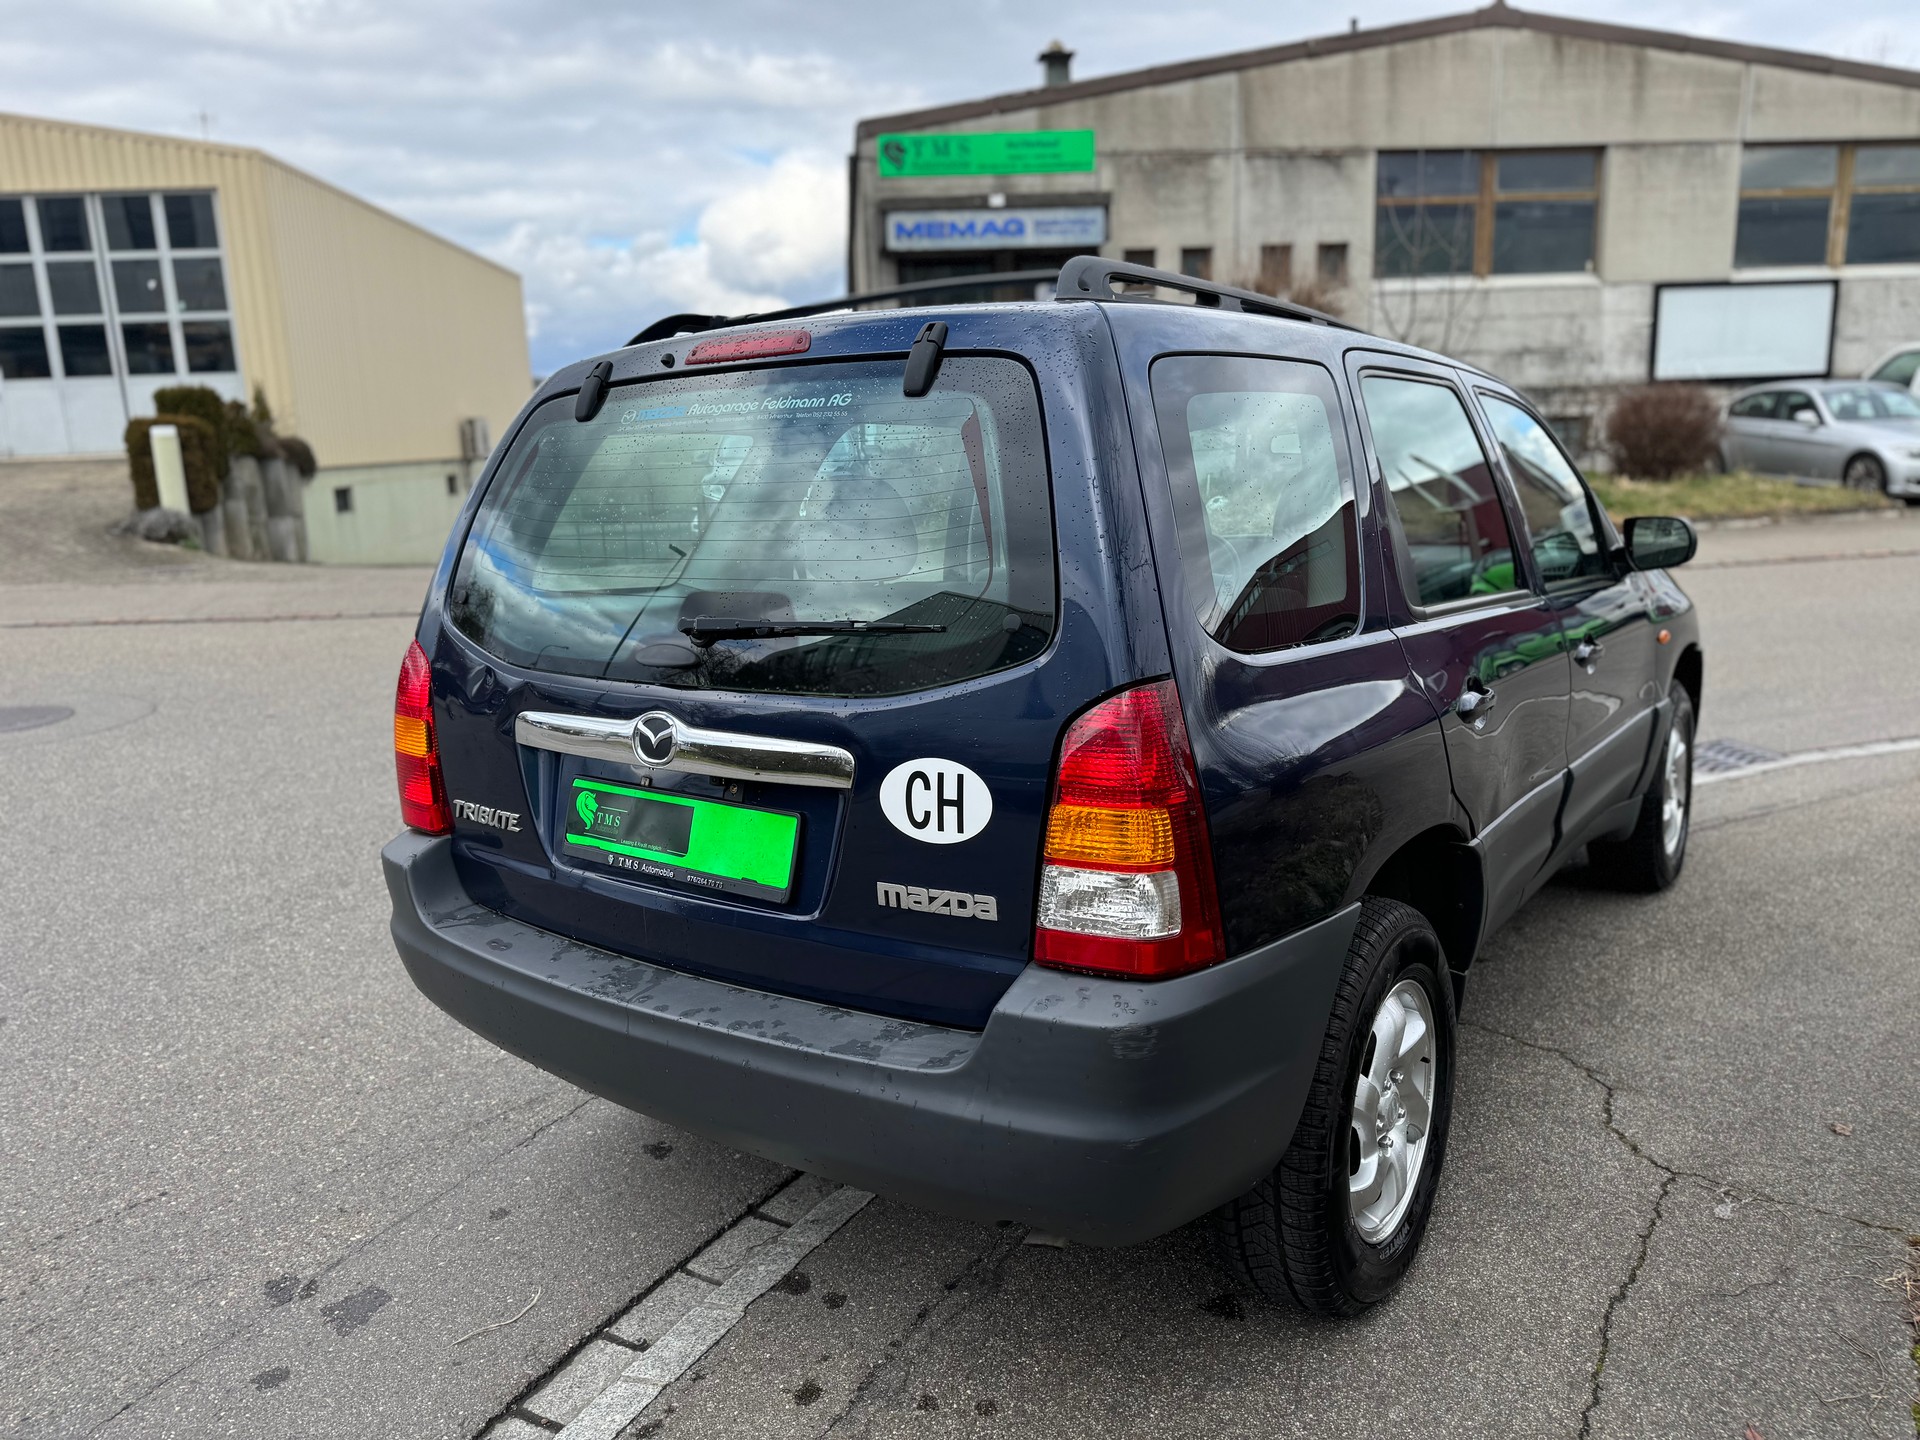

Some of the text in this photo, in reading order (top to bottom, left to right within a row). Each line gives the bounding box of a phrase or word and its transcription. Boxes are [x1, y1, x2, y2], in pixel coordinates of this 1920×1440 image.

[687, 401, 759, 416] Autogarage
[761, 396, 825, 410] Feldmann
[827, 393, 852, 407] AG
[453, 799, 522, 832] TRIBUTE
[905, 770, 964, 834] CH
[597, 812, 621, 827] TMS
[618, 857, 639, 870] TMS
[641, 863, 674, 878] Automobile
[876, 881, 998, 921] mazda
[1379, 1221, 1410, 1260] WINTER
